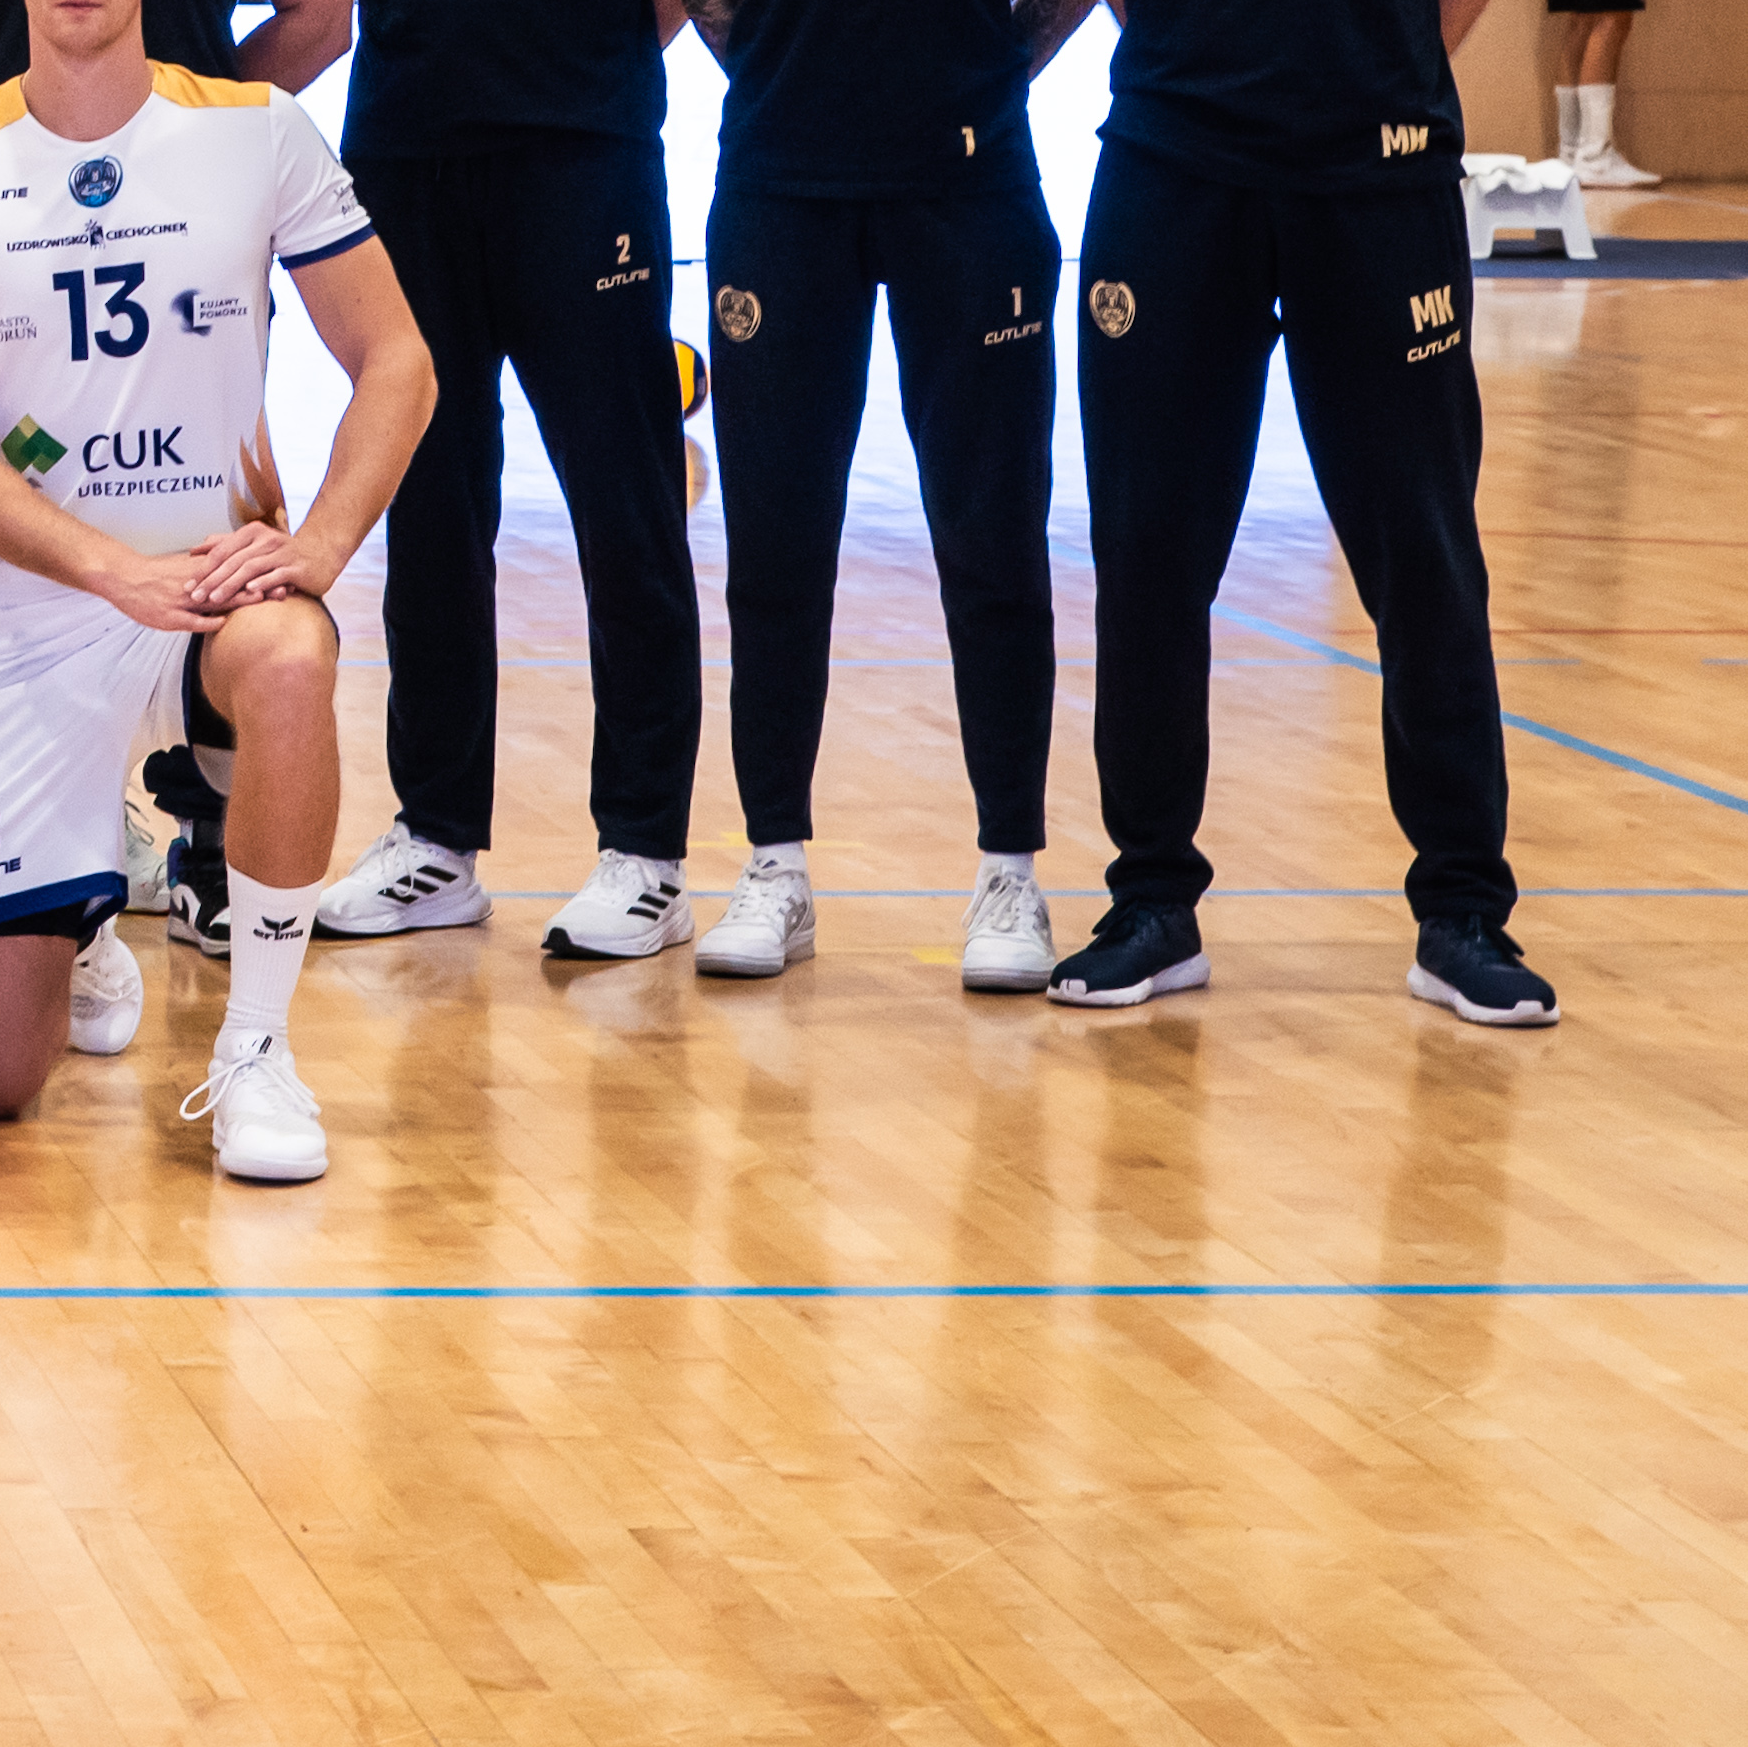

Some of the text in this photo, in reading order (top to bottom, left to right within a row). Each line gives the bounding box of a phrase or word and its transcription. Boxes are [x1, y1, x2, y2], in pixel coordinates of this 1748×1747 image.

[7, 220, 189, 253] UZDROWISKO CIECHOCINEK
[616, 233, 631, 266] 2
[595, 267, 651, 292] CUTLINE
[52, 262, 149, 362] 13
[1010, 286, 1022, 317] 1
[1408, 284, 1455, 333] MK
[984, 320, 1044, 346] CUTLINE
[82, 425, 185, 473] CUK
[77, 474, 226, 500] UBEZPIECZENIA
